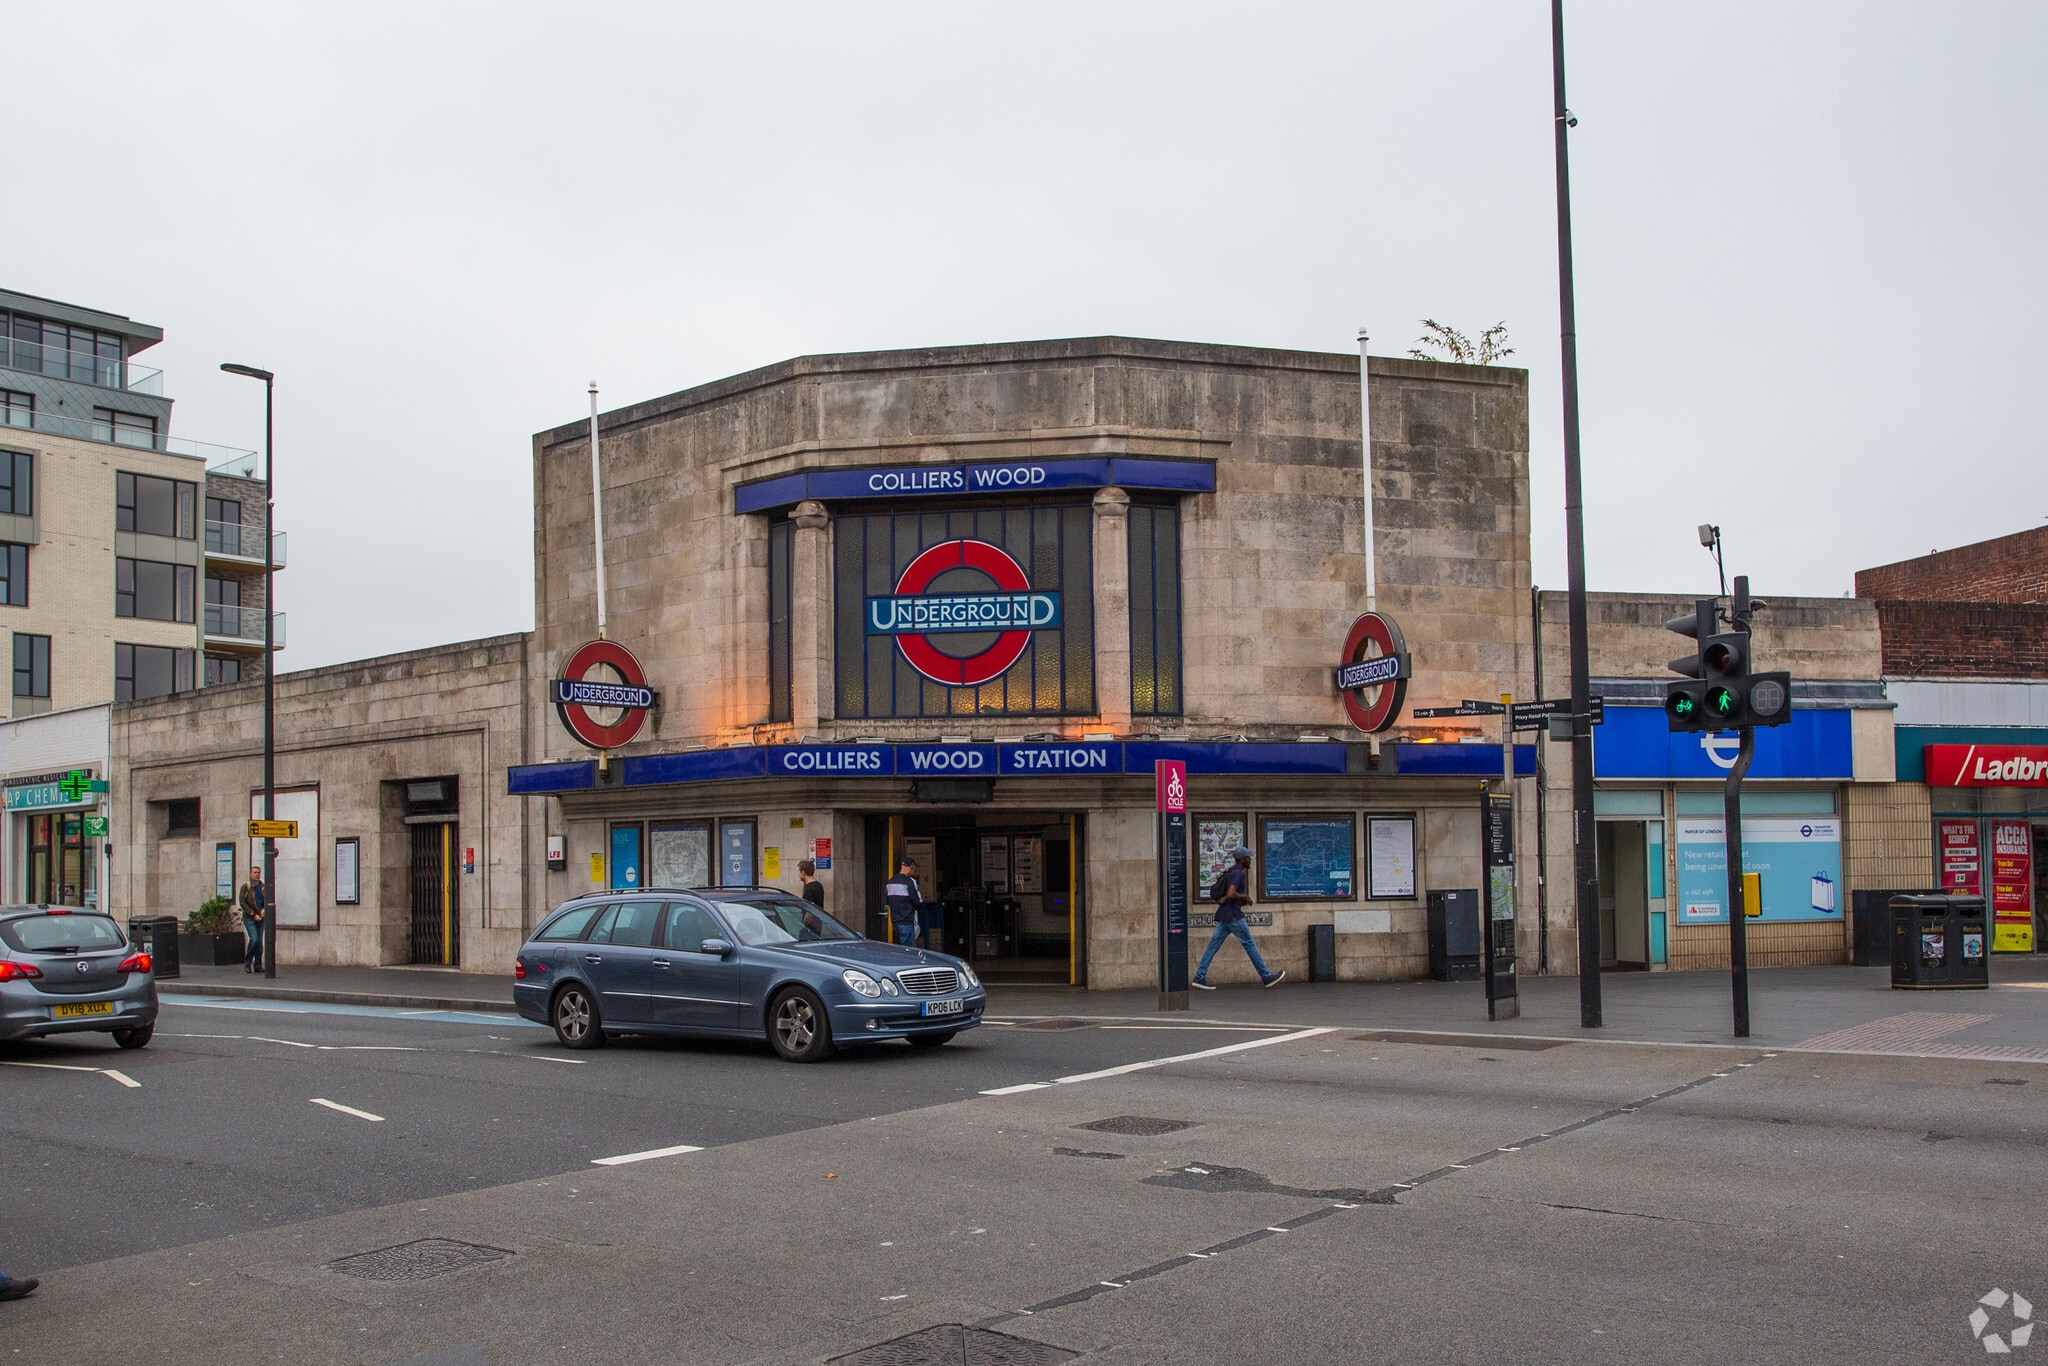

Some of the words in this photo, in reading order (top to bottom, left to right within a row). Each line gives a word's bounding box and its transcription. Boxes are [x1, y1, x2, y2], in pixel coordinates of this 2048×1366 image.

[868, 471, 964, 491] COLLIERS
[974, 466, 1046, 487] WOOD
[872, 594, 1055, 630] UNDERGROUND
[1337, 656, 1399, 689] UNDERGROUND
[559, 681, 652, 707] UNDERGROUND
[1531, 702, 1544, 711] Abbey
[783, 751, 881, 770] COLLIERS
[910, 750, 984, 769] WOOD
[1013, 749, 1107, 768] STATION
[1973, 757, 2048, 781] Ladbr
[7, 790, 21, 807] AP
[1167, 797, 1184, 806] CYCLE
[1942, 825, 1963, 835] WHAT'S
[1964, 825, 1975, 834] THE
[1996, 825, 2028, 845] ACCA
[1948, 835, 1969, 844] SCORE?
[549, 850, 561, 859] LFB
[1704, 850, 1724, 858] retail
[1996, 845, 2028, 854] INSURANCE
[1685, 862, 1707, 872] being
[1962, 926, 1982, 934] Recycle
[61, 1004, 85, 1015] DY18
[87, 1001, 107, 1013] XUX
[927, 1002, 948, 1014] KP06
[949, 1000, 962, 1012] LCK
